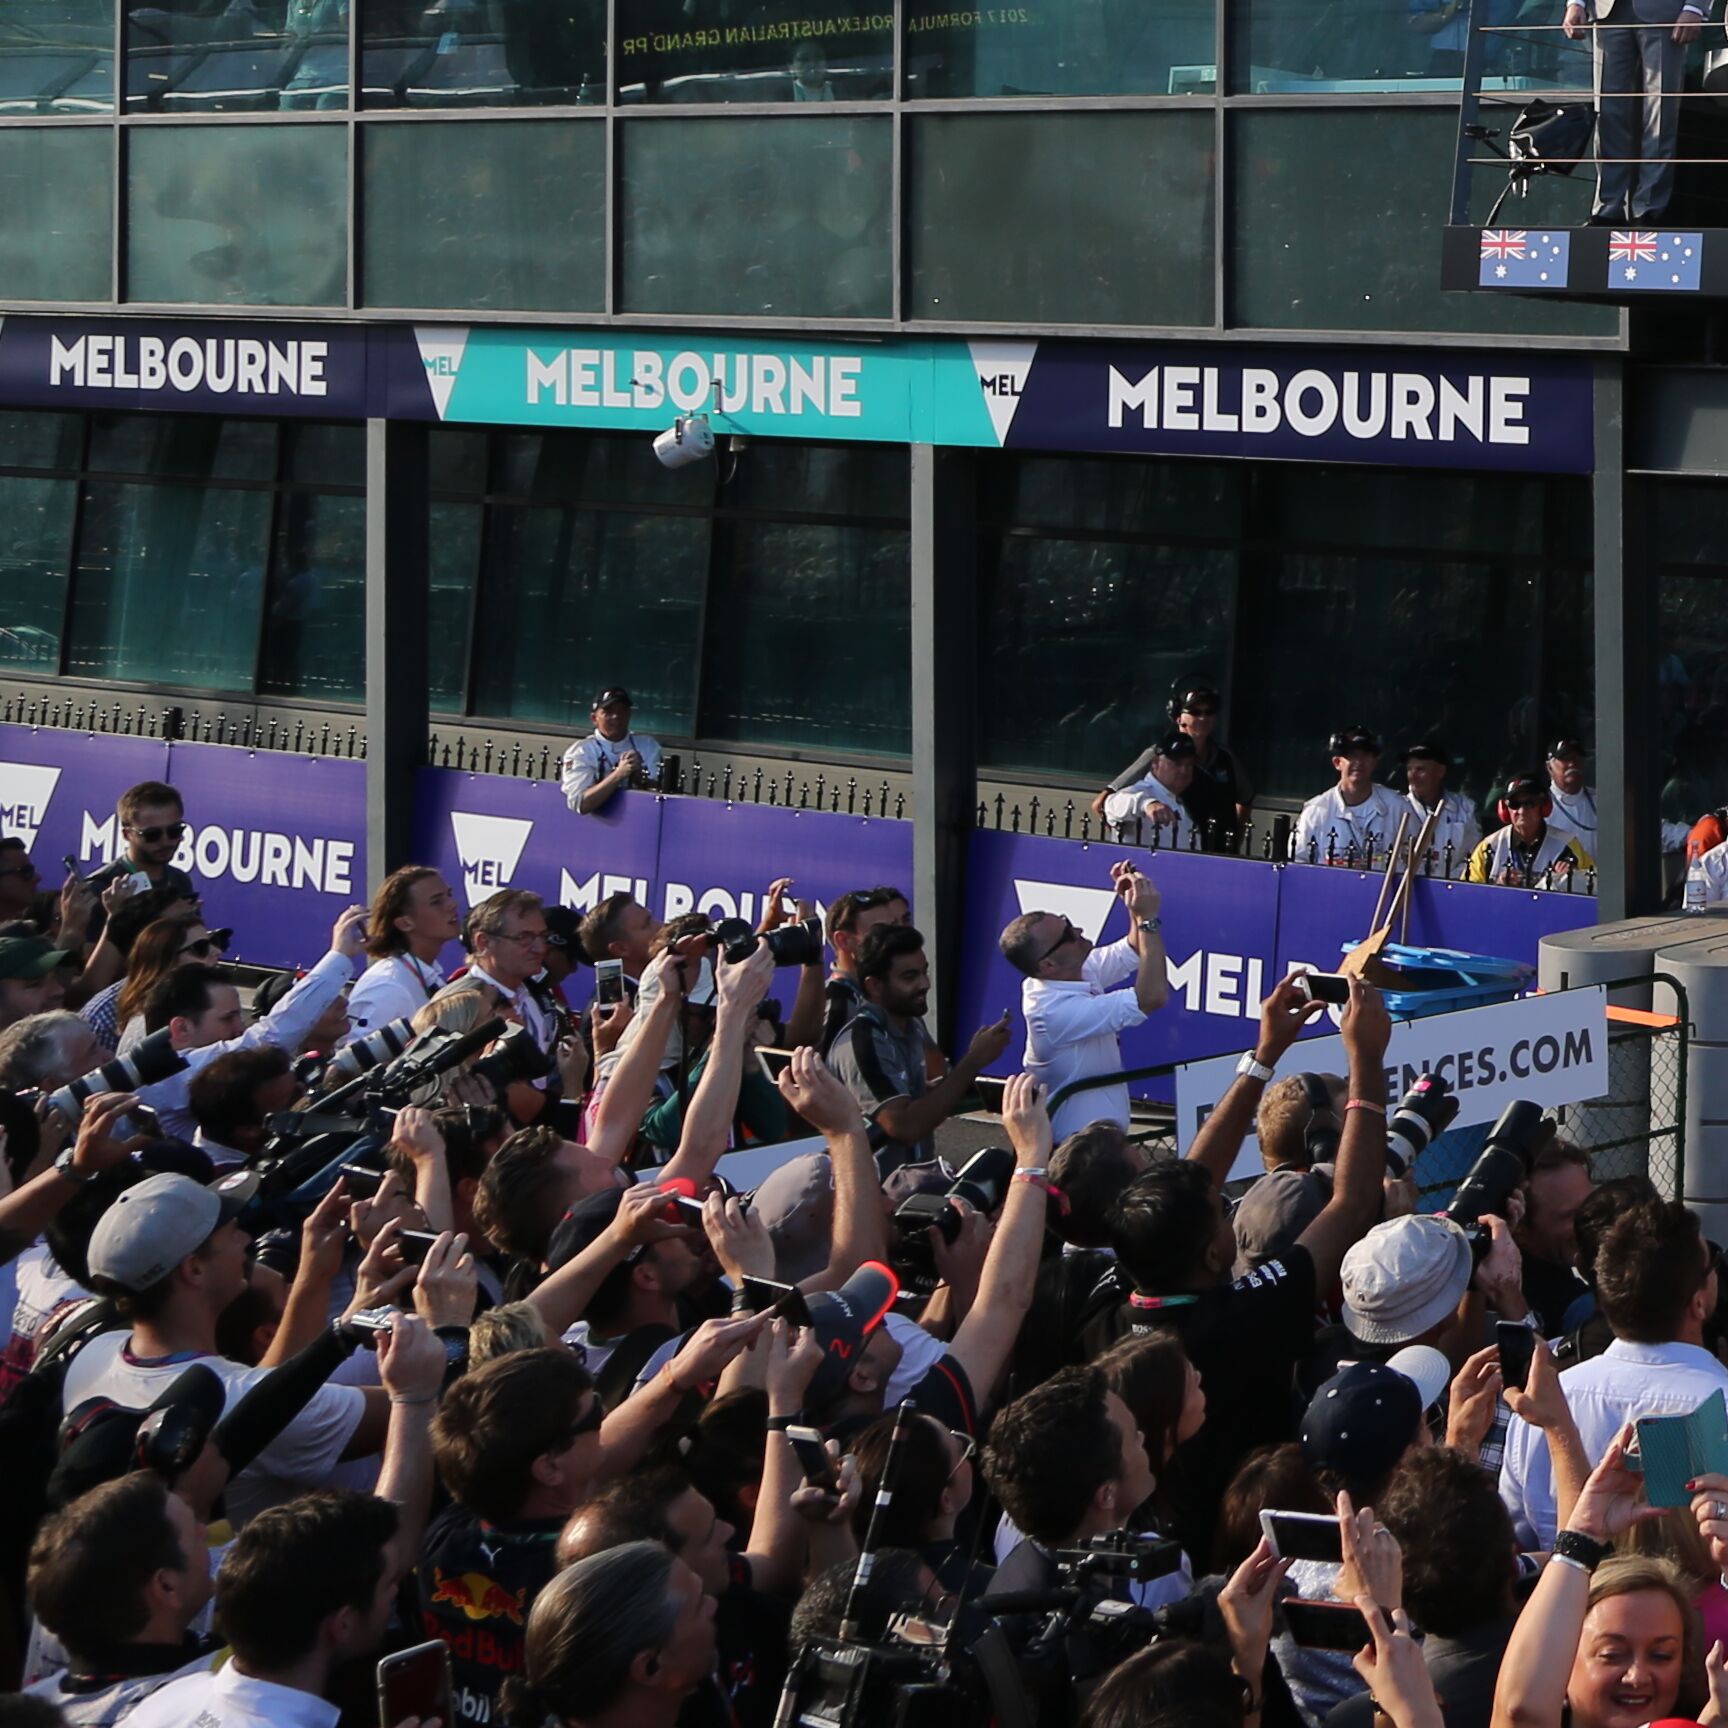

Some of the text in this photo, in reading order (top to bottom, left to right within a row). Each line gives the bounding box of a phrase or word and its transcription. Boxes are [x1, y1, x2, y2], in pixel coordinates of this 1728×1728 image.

[49, 334, 328, 397] MELBOURNE
[422, 348, 862, 418] MEL MELBOURNE
[980, 364, 1531, 445] MEL MELBOURNE
[0, 804, 354, 895] MEL MBOURNE
[462, 858, 508, 888] MEL
[1384, 1027, 1594, 1105] ENCES.COM
